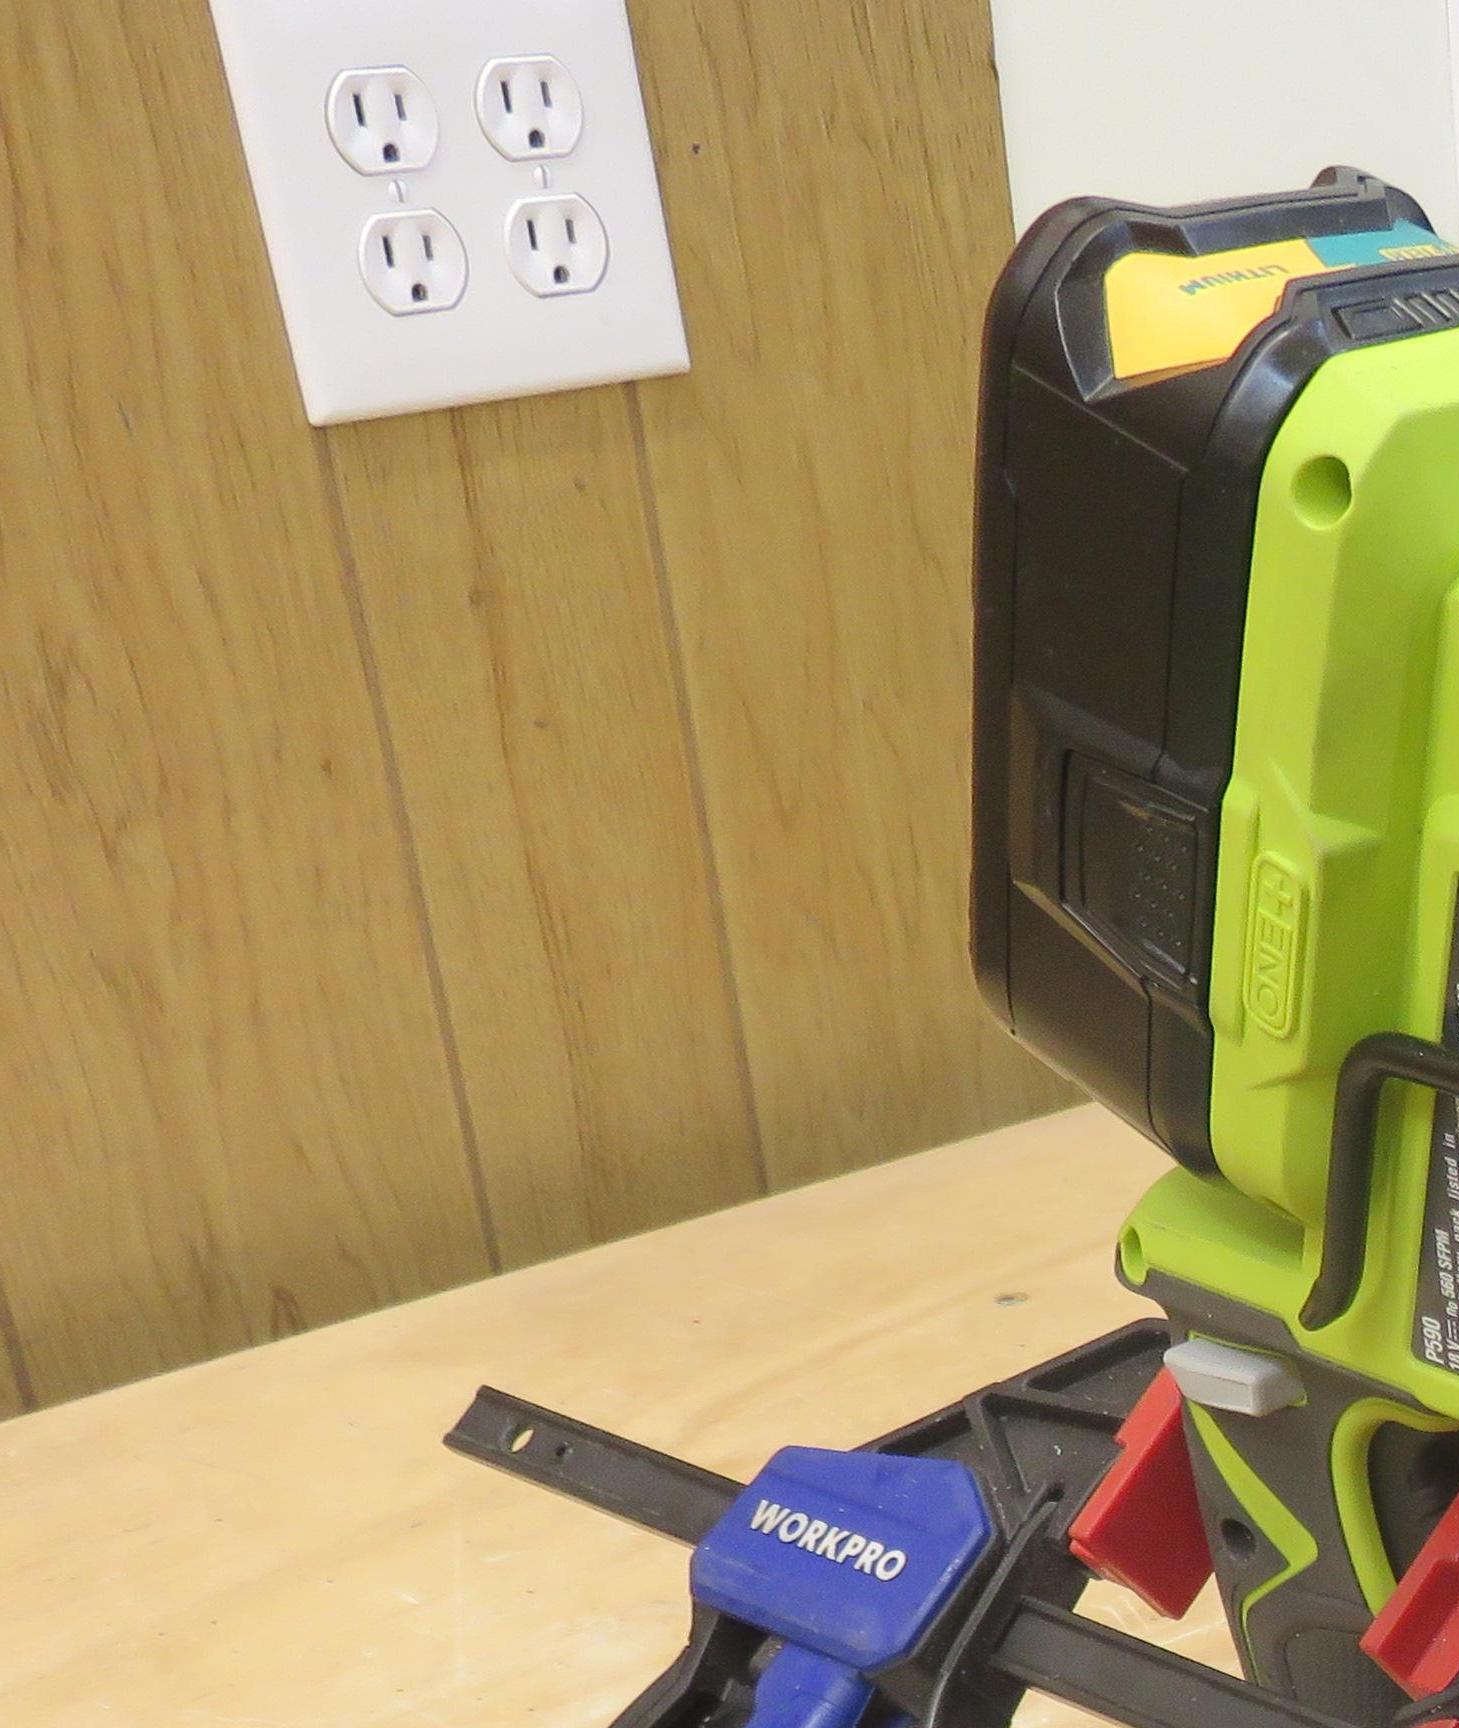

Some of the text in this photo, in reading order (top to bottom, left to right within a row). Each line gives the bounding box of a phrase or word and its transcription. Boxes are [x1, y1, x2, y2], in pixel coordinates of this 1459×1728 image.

[1177, 264, 1290, 297] LITHIUM
[1444, 1133, 1454, 1149] in
[1446, 1157, 1459, 1200] listed
[1436, 1228, 1451, 1270] SFPM
[1440, 1274, 1455, 1298] 560
[1421, 1316, 1444, 1364] P590
[749, 1498, 909, 1582] WORKPRO
